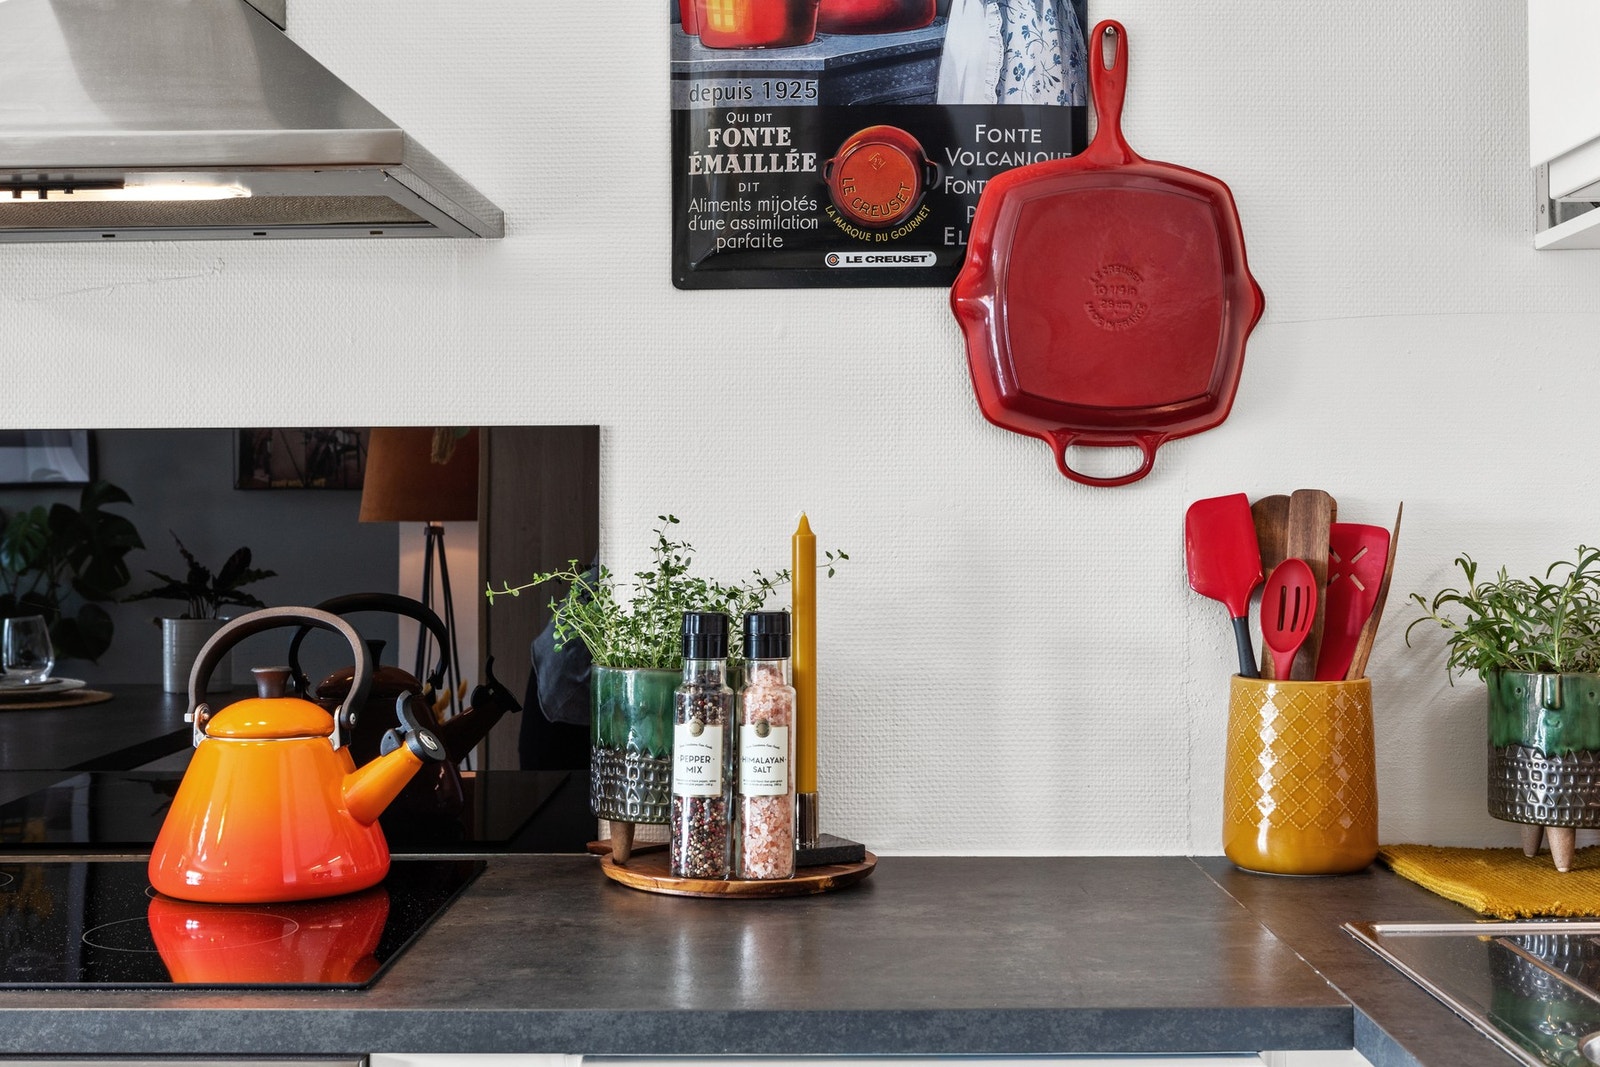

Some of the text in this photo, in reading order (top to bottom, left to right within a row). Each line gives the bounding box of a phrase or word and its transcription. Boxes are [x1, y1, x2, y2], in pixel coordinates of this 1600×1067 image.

[689, 80, 817, 107] depuis 1925
[726, 111, 772, 124] QUI DIT
[707, 126, 791, 148] FONTE
[975, 124, 1042, 143] FONTE
[688, 148, 817, 175] ÉMAILLÉE
[738, 182, 760, 193] DIT
[944, 175, 989, 195] FONT
[688, 194, 818, 216] Aliments mijotés
[842, 177, 911, 218] LE CREUSET
[688, 214, 819, 231] d'une assimilation
[825, 205, 836, 218] LA
[833, 216, 872, 242] MARQUE
[875, 233, 888, 242] DU
[890, 204, 931, 239] GOURMET
[716, 232, 784, 253] parfaite
[846, 256, 863, 264] LE
[680, 754, 711, 764] PEPPER
[686, 765, 703, 774] MIX
[753, 766, 772, 774] SALT
